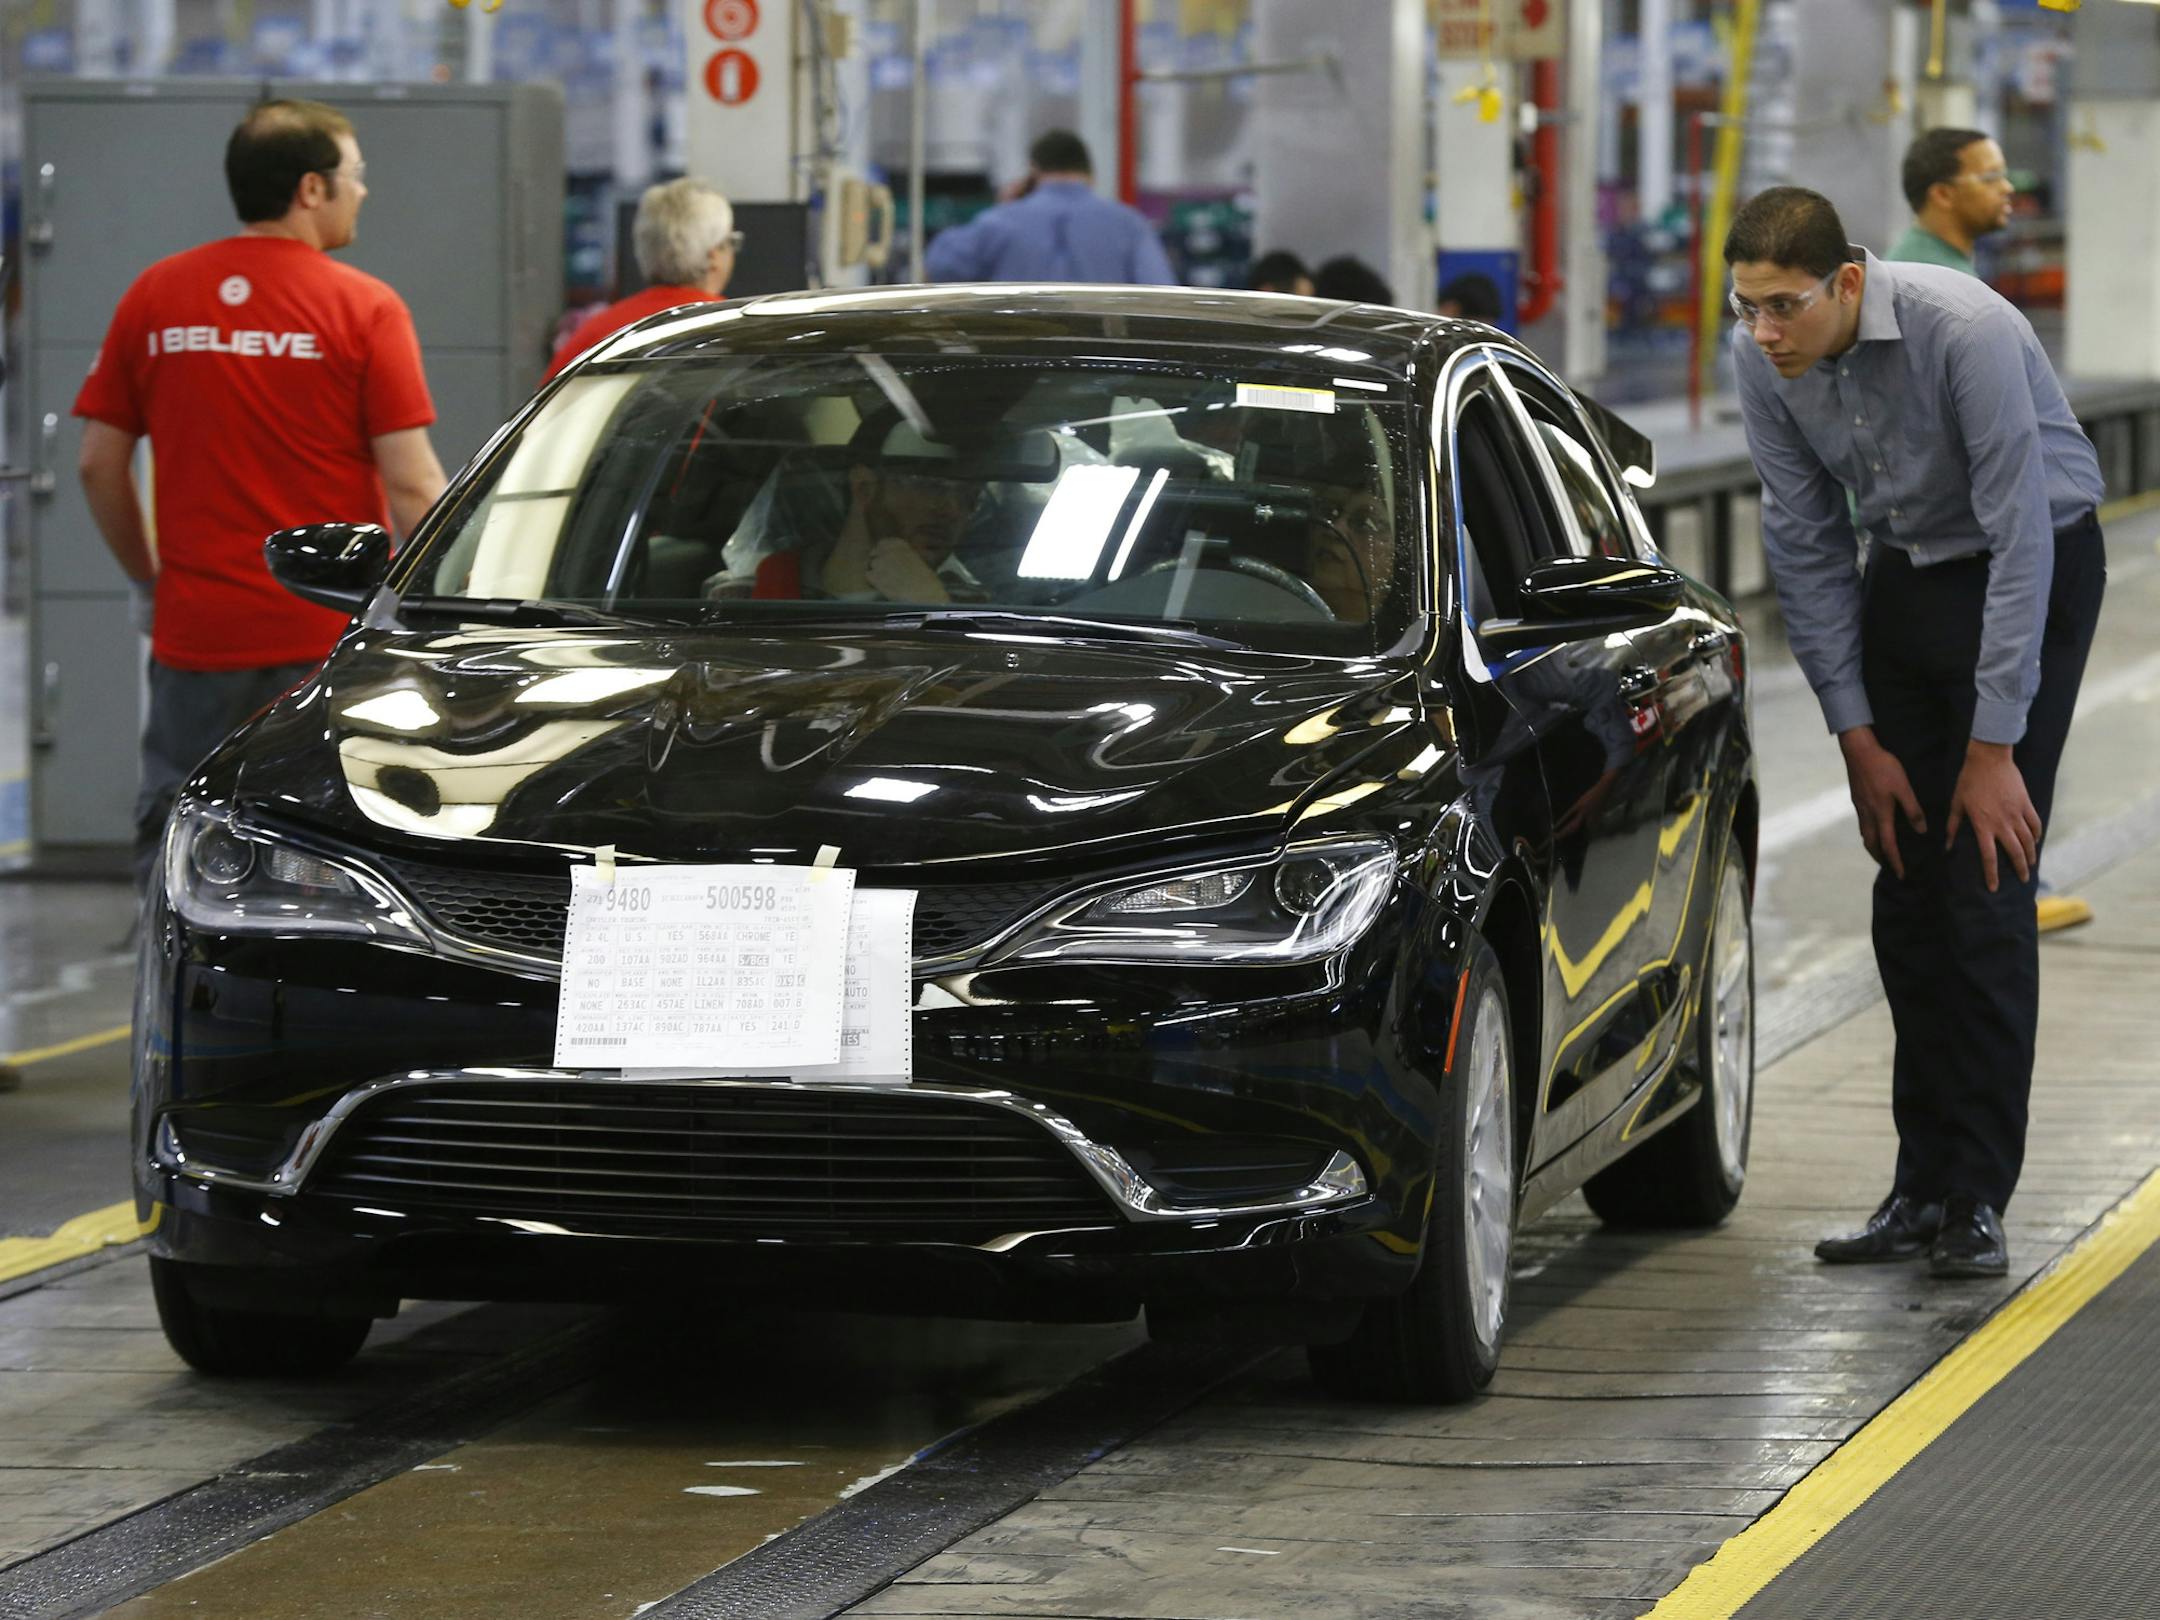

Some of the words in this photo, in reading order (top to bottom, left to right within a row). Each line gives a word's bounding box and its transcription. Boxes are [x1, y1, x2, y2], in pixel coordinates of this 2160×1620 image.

[148, 331, 158, 357] I
[162, 325, 323, 360] BELIEVE.
[607, 887, 651, 911] 9480
[706, 886, 776, 910] 500598
[667, 931, 684, 941] YES
[736, 932, 771, 942] CHROME
[587, 955, 606, 965] 200
[587, 979, 600, 988] NO
[621, 978, 645, 987] BASE
[661, 977, 683, 987] NONE
[845, 987, 868, 997] AUTO
[580, 1000, 604, 1010] NONE
[657, 999, 686, 1009] 457AE
[694, 999, 724, 1009] LINEN
[693, 1023, 722, 1032] 787AA
[740, 1021, 757, 1031] YES
